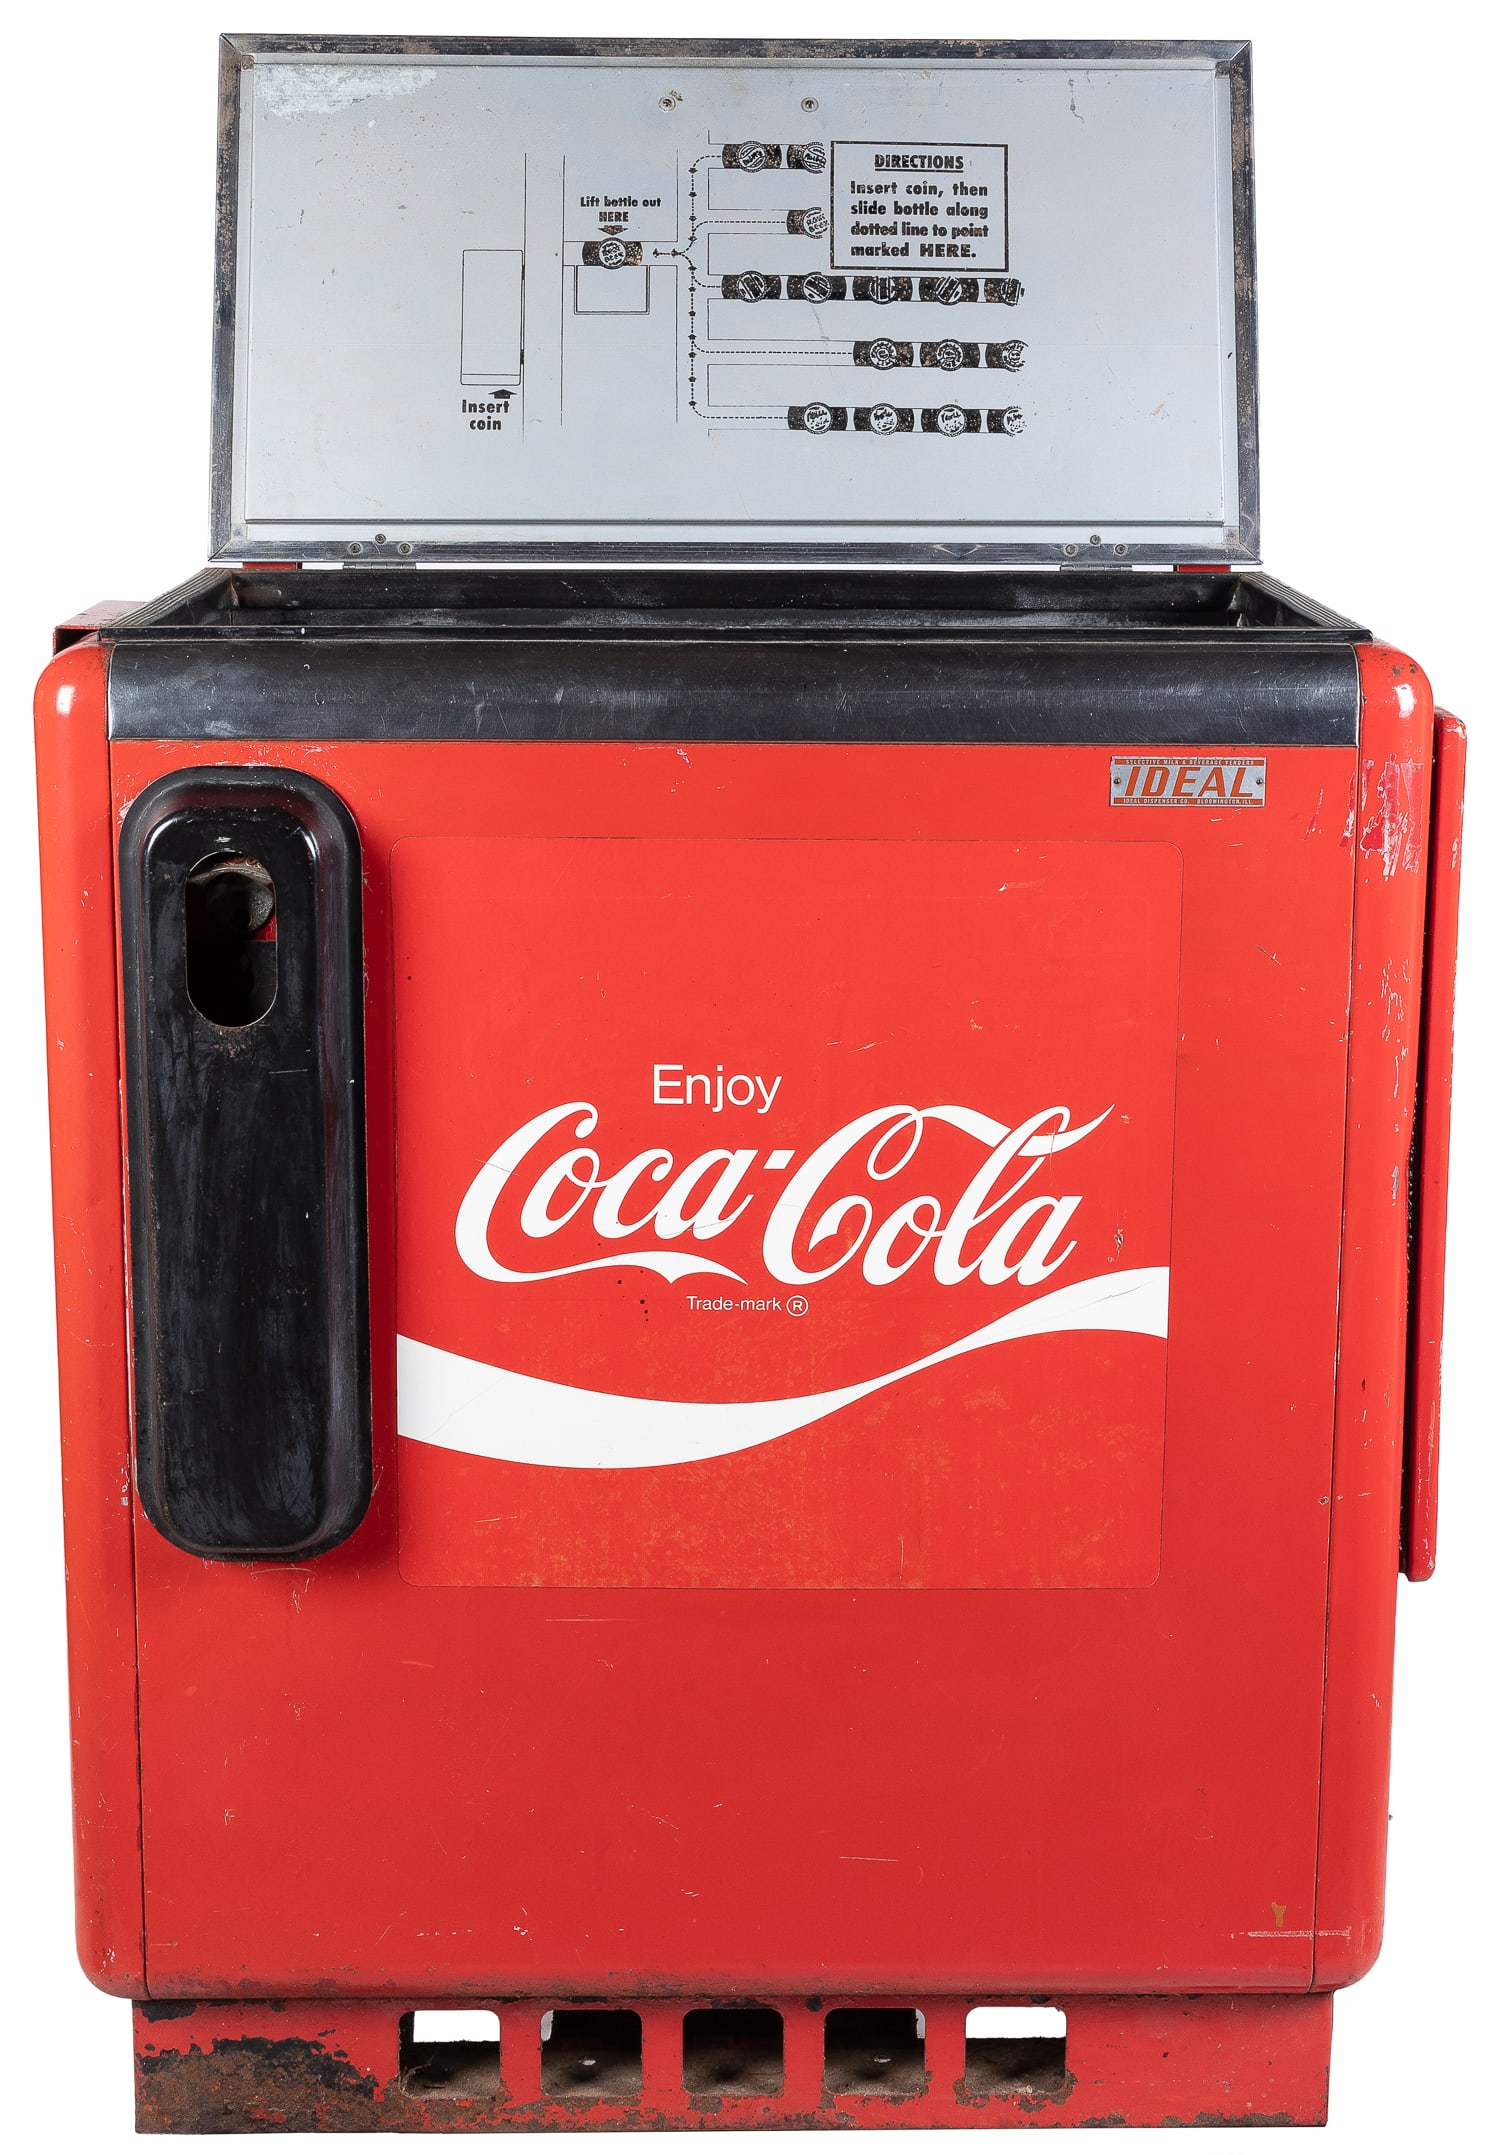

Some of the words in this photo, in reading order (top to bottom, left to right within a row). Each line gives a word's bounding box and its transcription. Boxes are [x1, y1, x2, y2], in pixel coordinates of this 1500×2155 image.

[875, 154, 963, 169] DIRECTIONS
[851, 181, 897, 194] Insert
[906, 181, 943, 198] coin,
[953, 181, 987, 196] then
[581, 196, 600, 207] Lift
[604, 196, 638, 208] bottle
[643, 198, 661, 207] out
[599, 212, 628, 222] HERE
[851, 201, 886, 215] slide
[894, 201, 938, 215] bottle
[946, 202, 988, 219] along
[851, 221, 897, 235] dotted
[902, 222, 928, 236] line
[932, 224, 947, 237] to
[952, 223, 989, 239] point
[851, 242, 909, 256] marked
[920, 244, 976, 257] HERE.
[462, 400, 509, 413] Insert
[470, 416, 501, 430] coin
[1125, 766, 1253, 797] IDEAL
[654, 1065, 782, 1113] Enjoy
[455, 1101, 1115, 1286] Coca-Cola
[687, 1296, 781, 1310] Trade-mark
